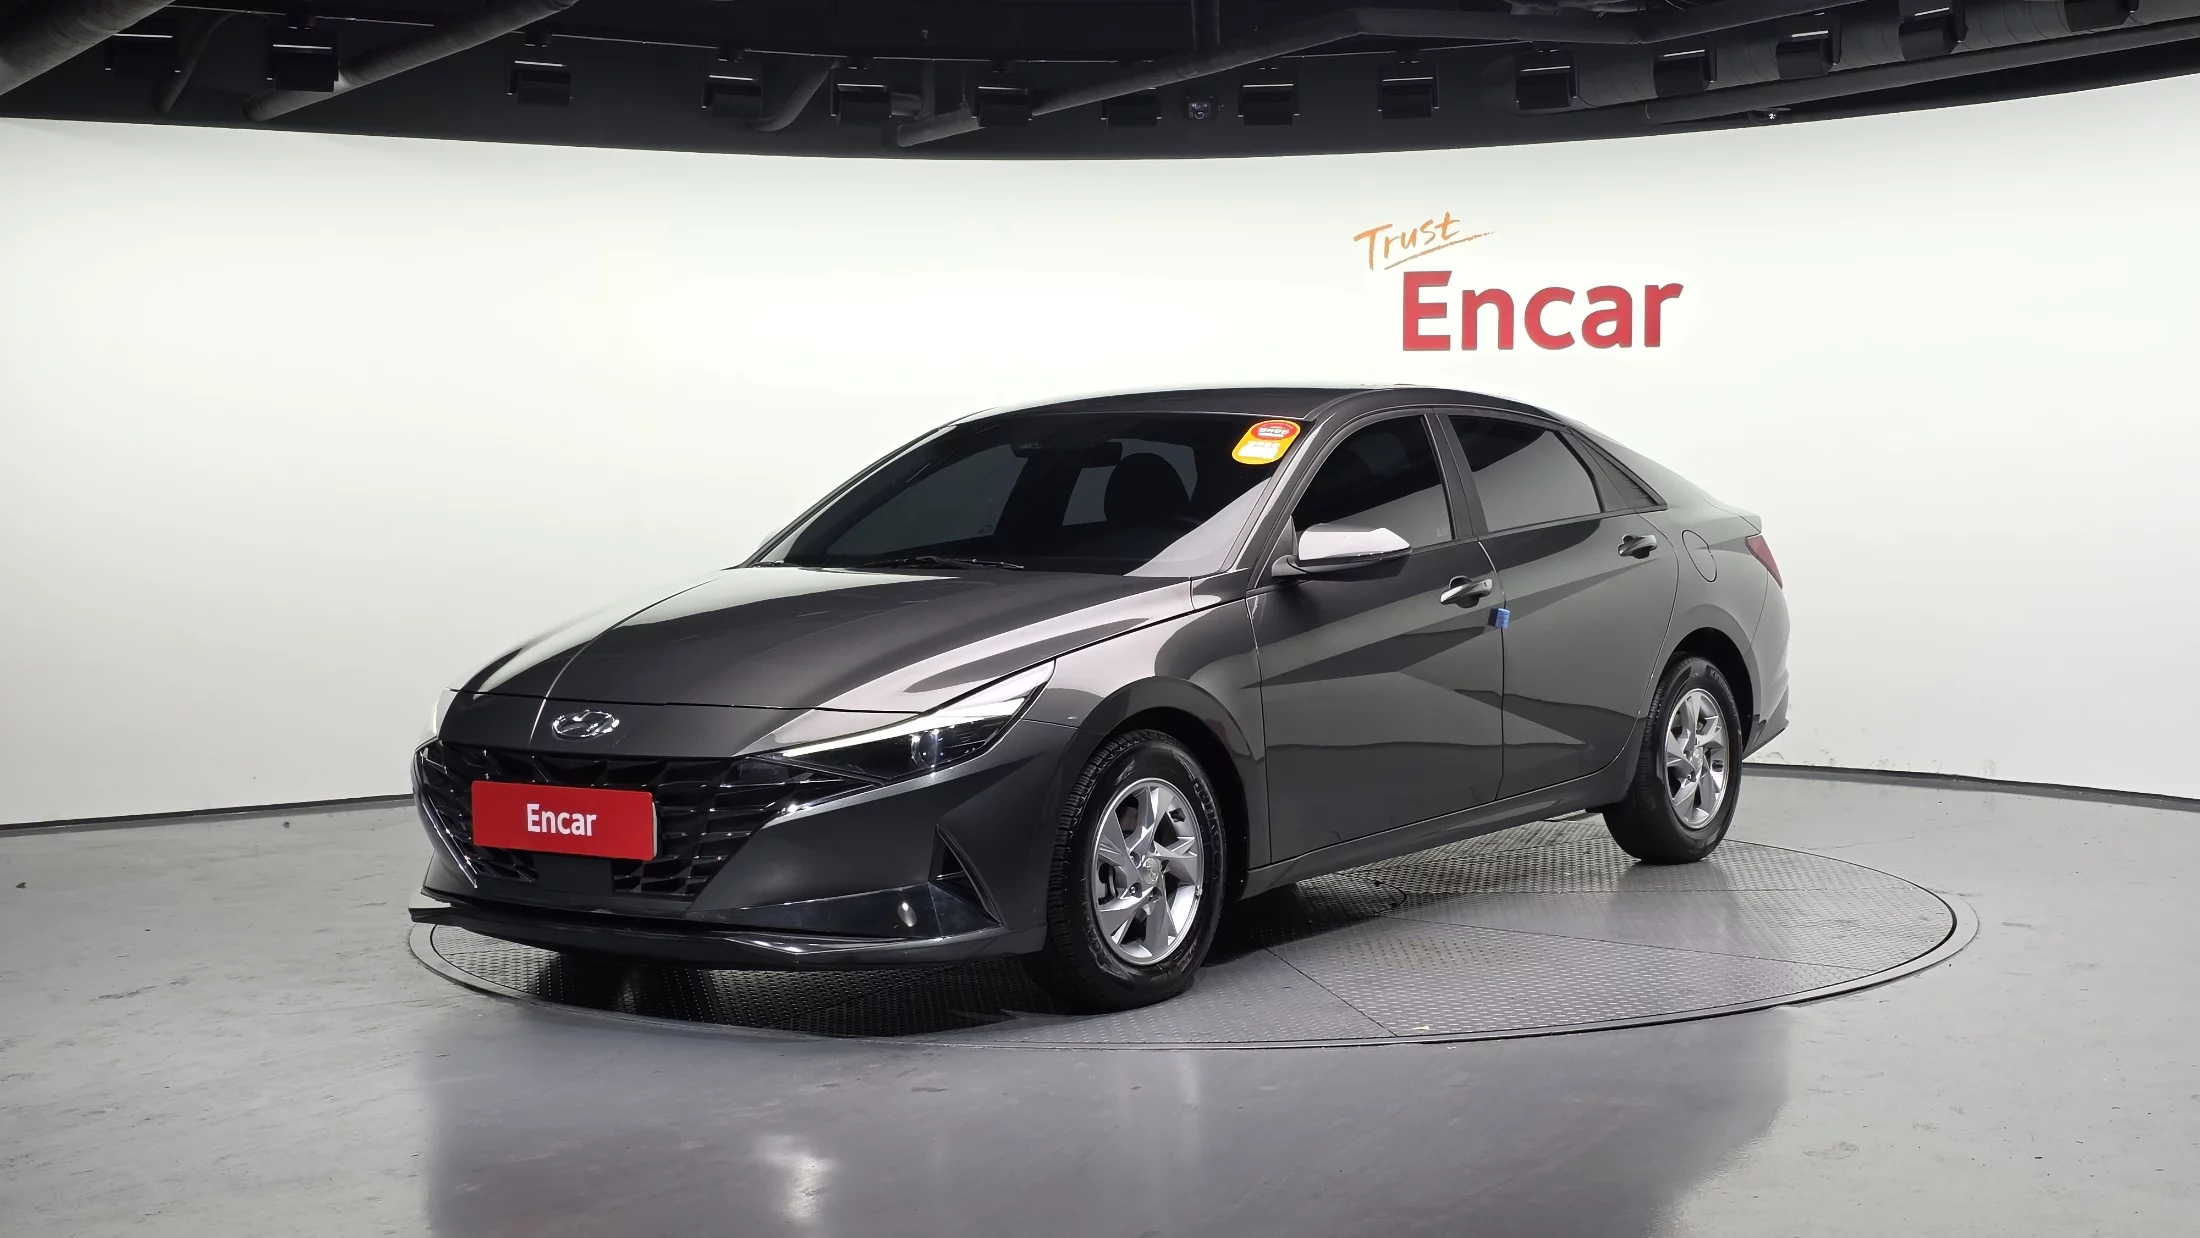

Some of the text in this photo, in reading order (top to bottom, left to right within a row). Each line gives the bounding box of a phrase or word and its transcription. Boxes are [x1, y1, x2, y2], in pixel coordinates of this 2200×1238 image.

[1353, 211, 1461, 270] Trust
[1403, 270, 1684, 351] Encar
[526, 803, 597, 836] Encar
